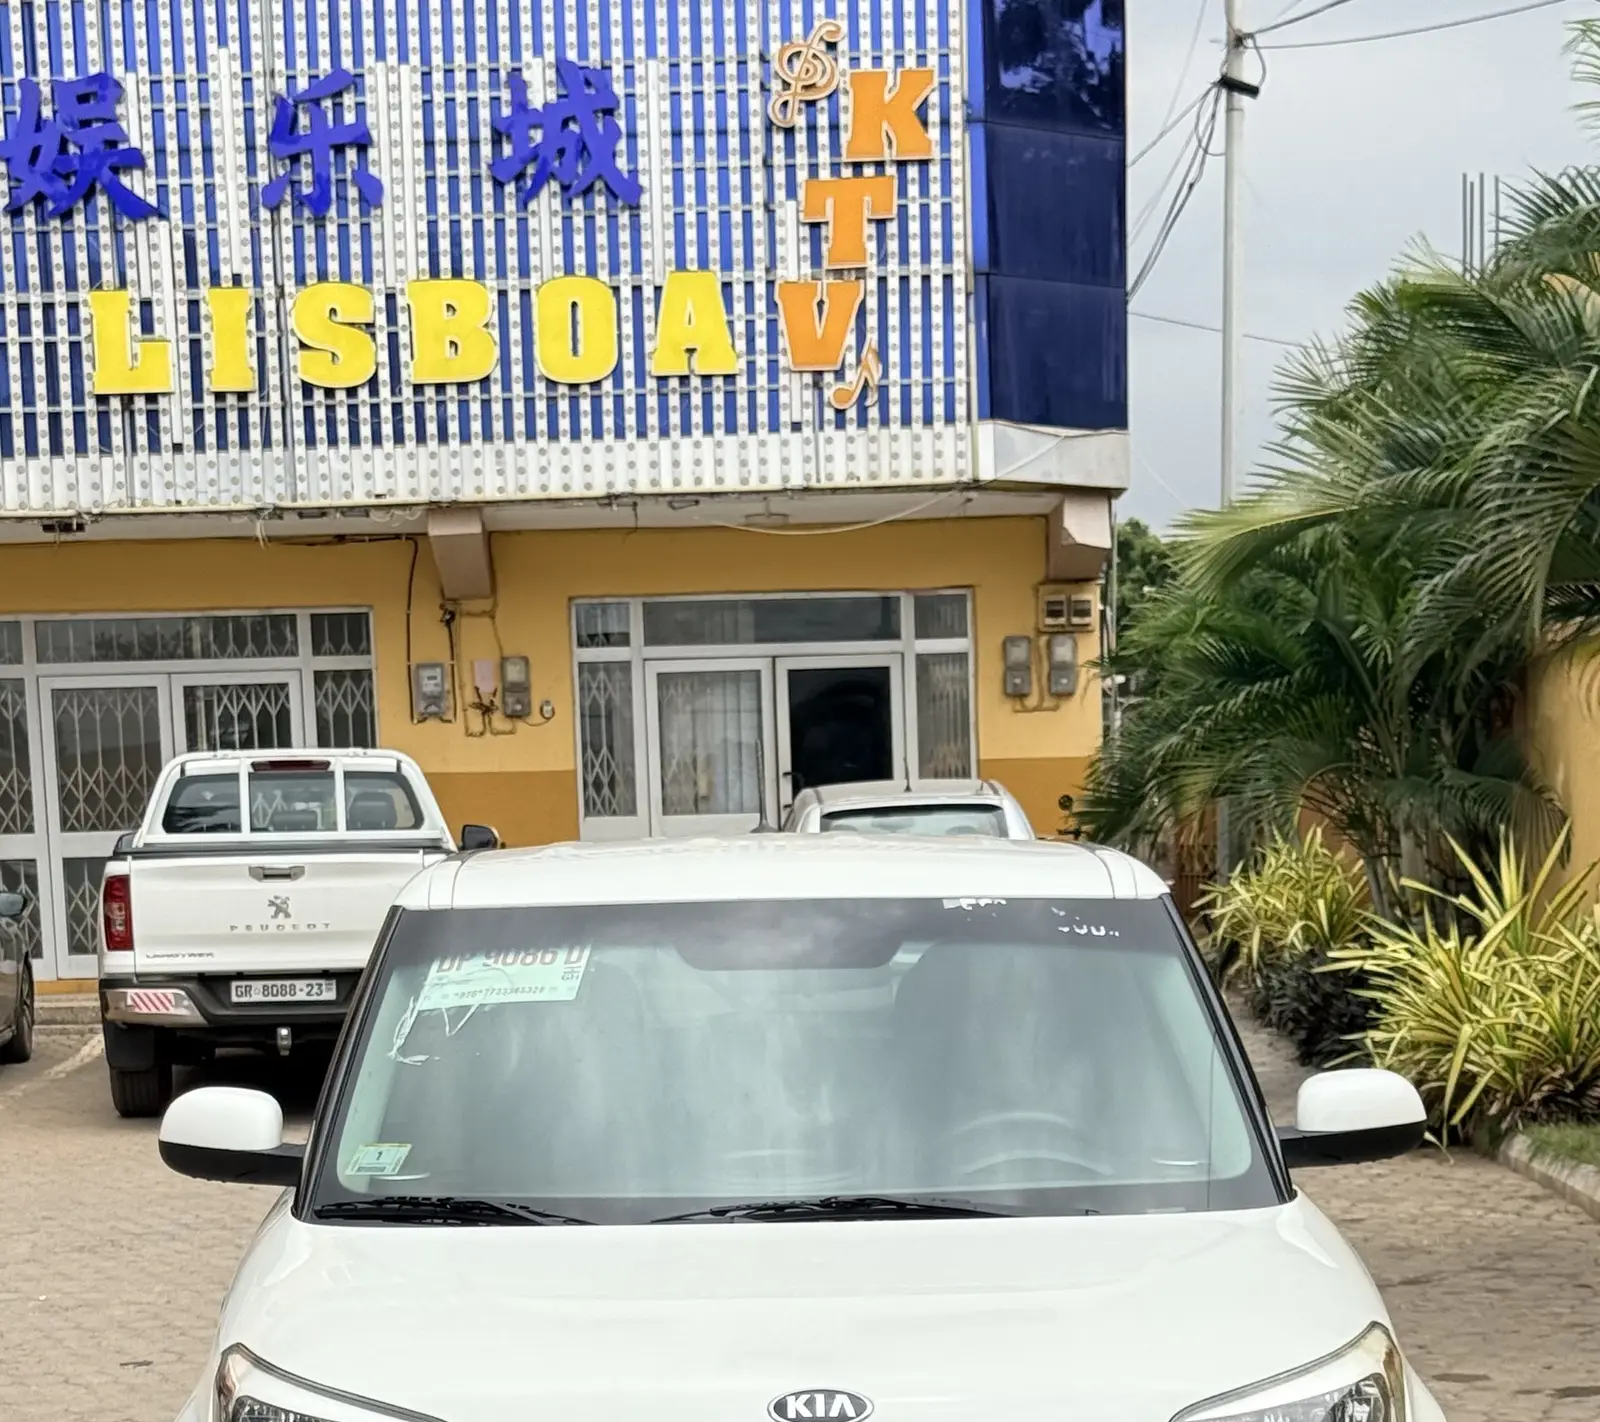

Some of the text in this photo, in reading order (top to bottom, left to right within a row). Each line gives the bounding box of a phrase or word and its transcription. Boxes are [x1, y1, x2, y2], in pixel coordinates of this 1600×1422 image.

[0, 56, 642, 221] 娱乐城
[775, 67, 936, 372] KTV
[90, 269, 740, 395] LISBOA
[229, 922, 331, 932] PEUGEOT
[234, 984, 253, 998] GR
[785, 1393, 857, 1419] KIA
